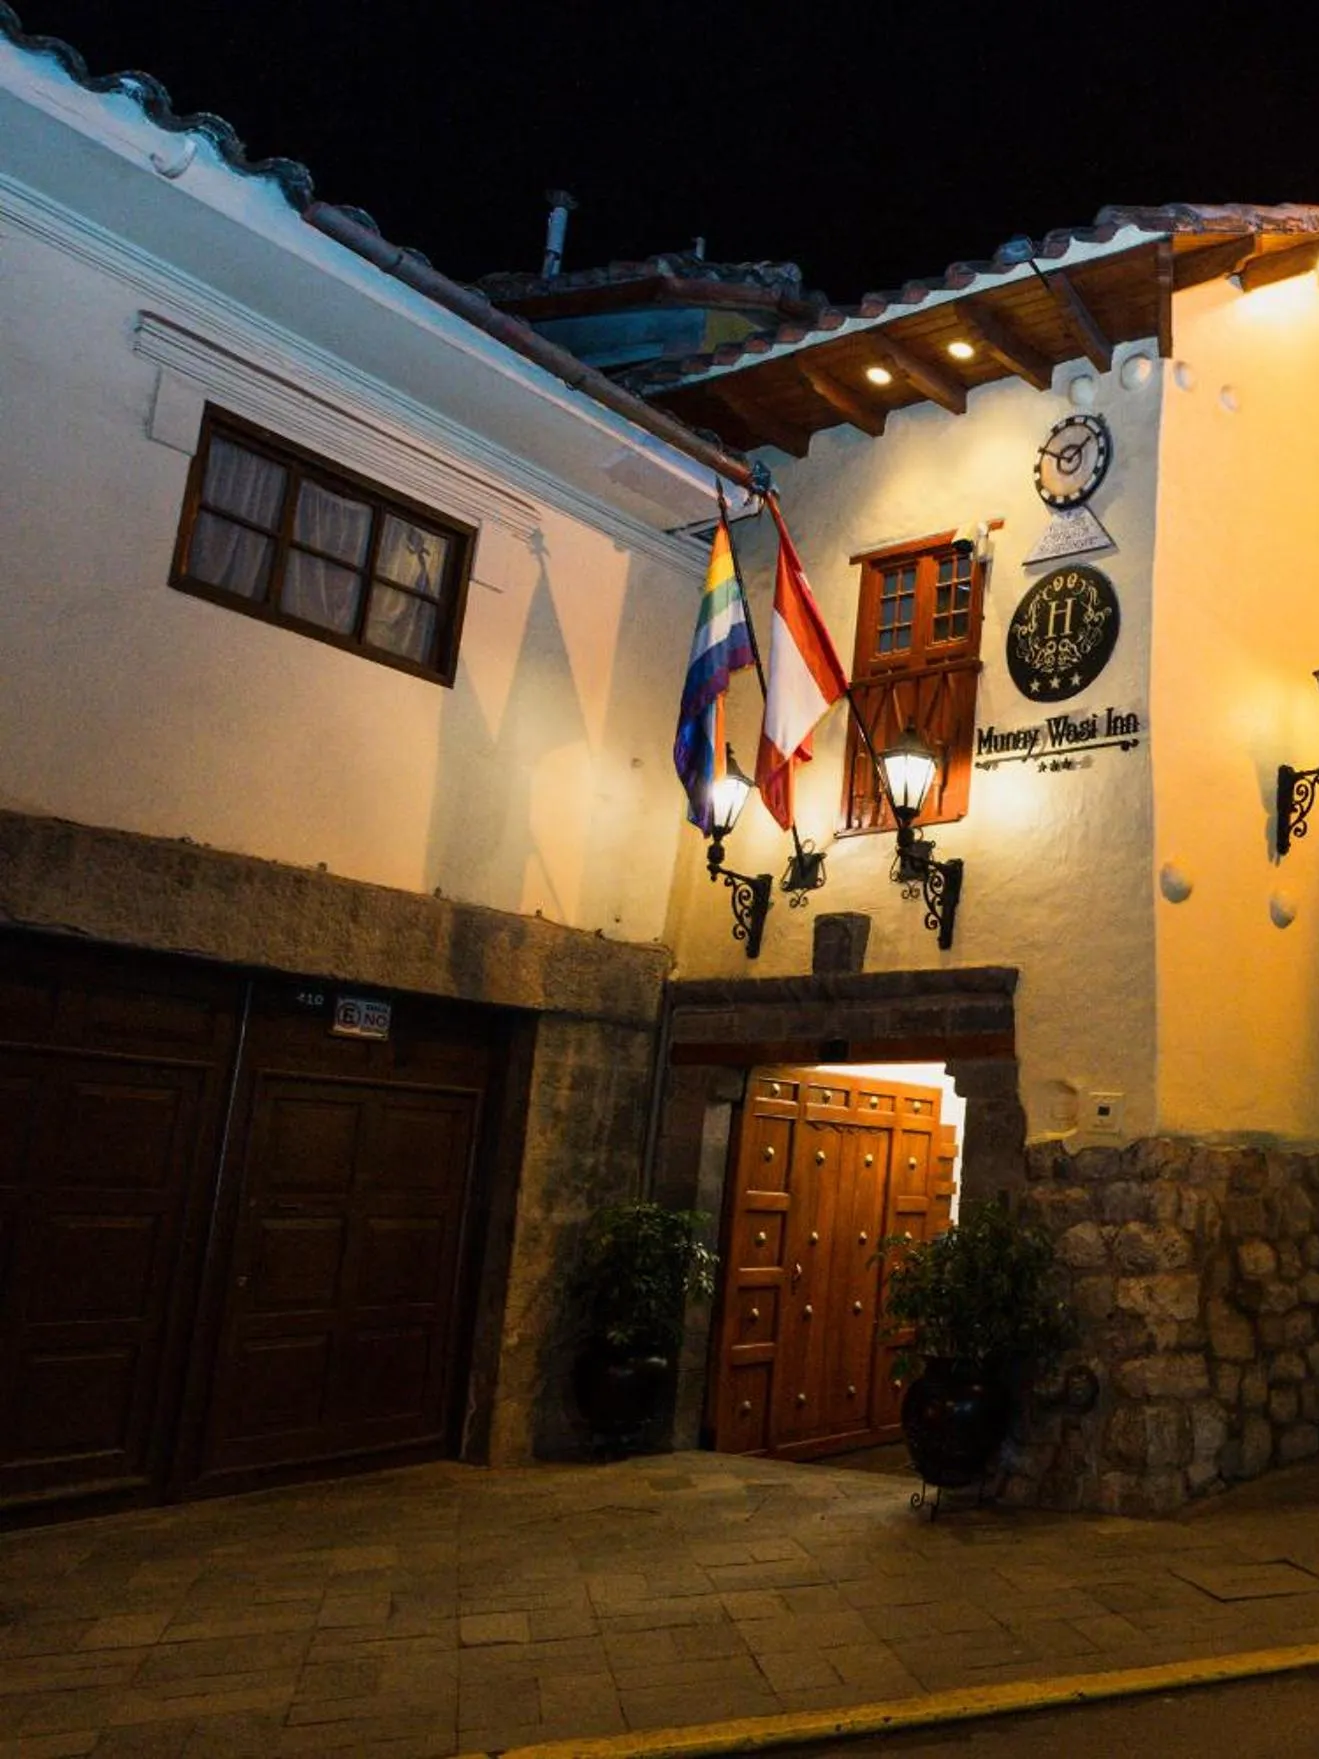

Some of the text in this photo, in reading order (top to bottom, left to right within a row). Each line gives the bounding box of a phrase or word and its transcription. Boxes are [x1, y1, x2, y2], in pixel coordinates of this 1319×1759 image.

[1047, 597, 1076, 639] H
[977, 707, 1140, 760] Munay Wasi Inn
